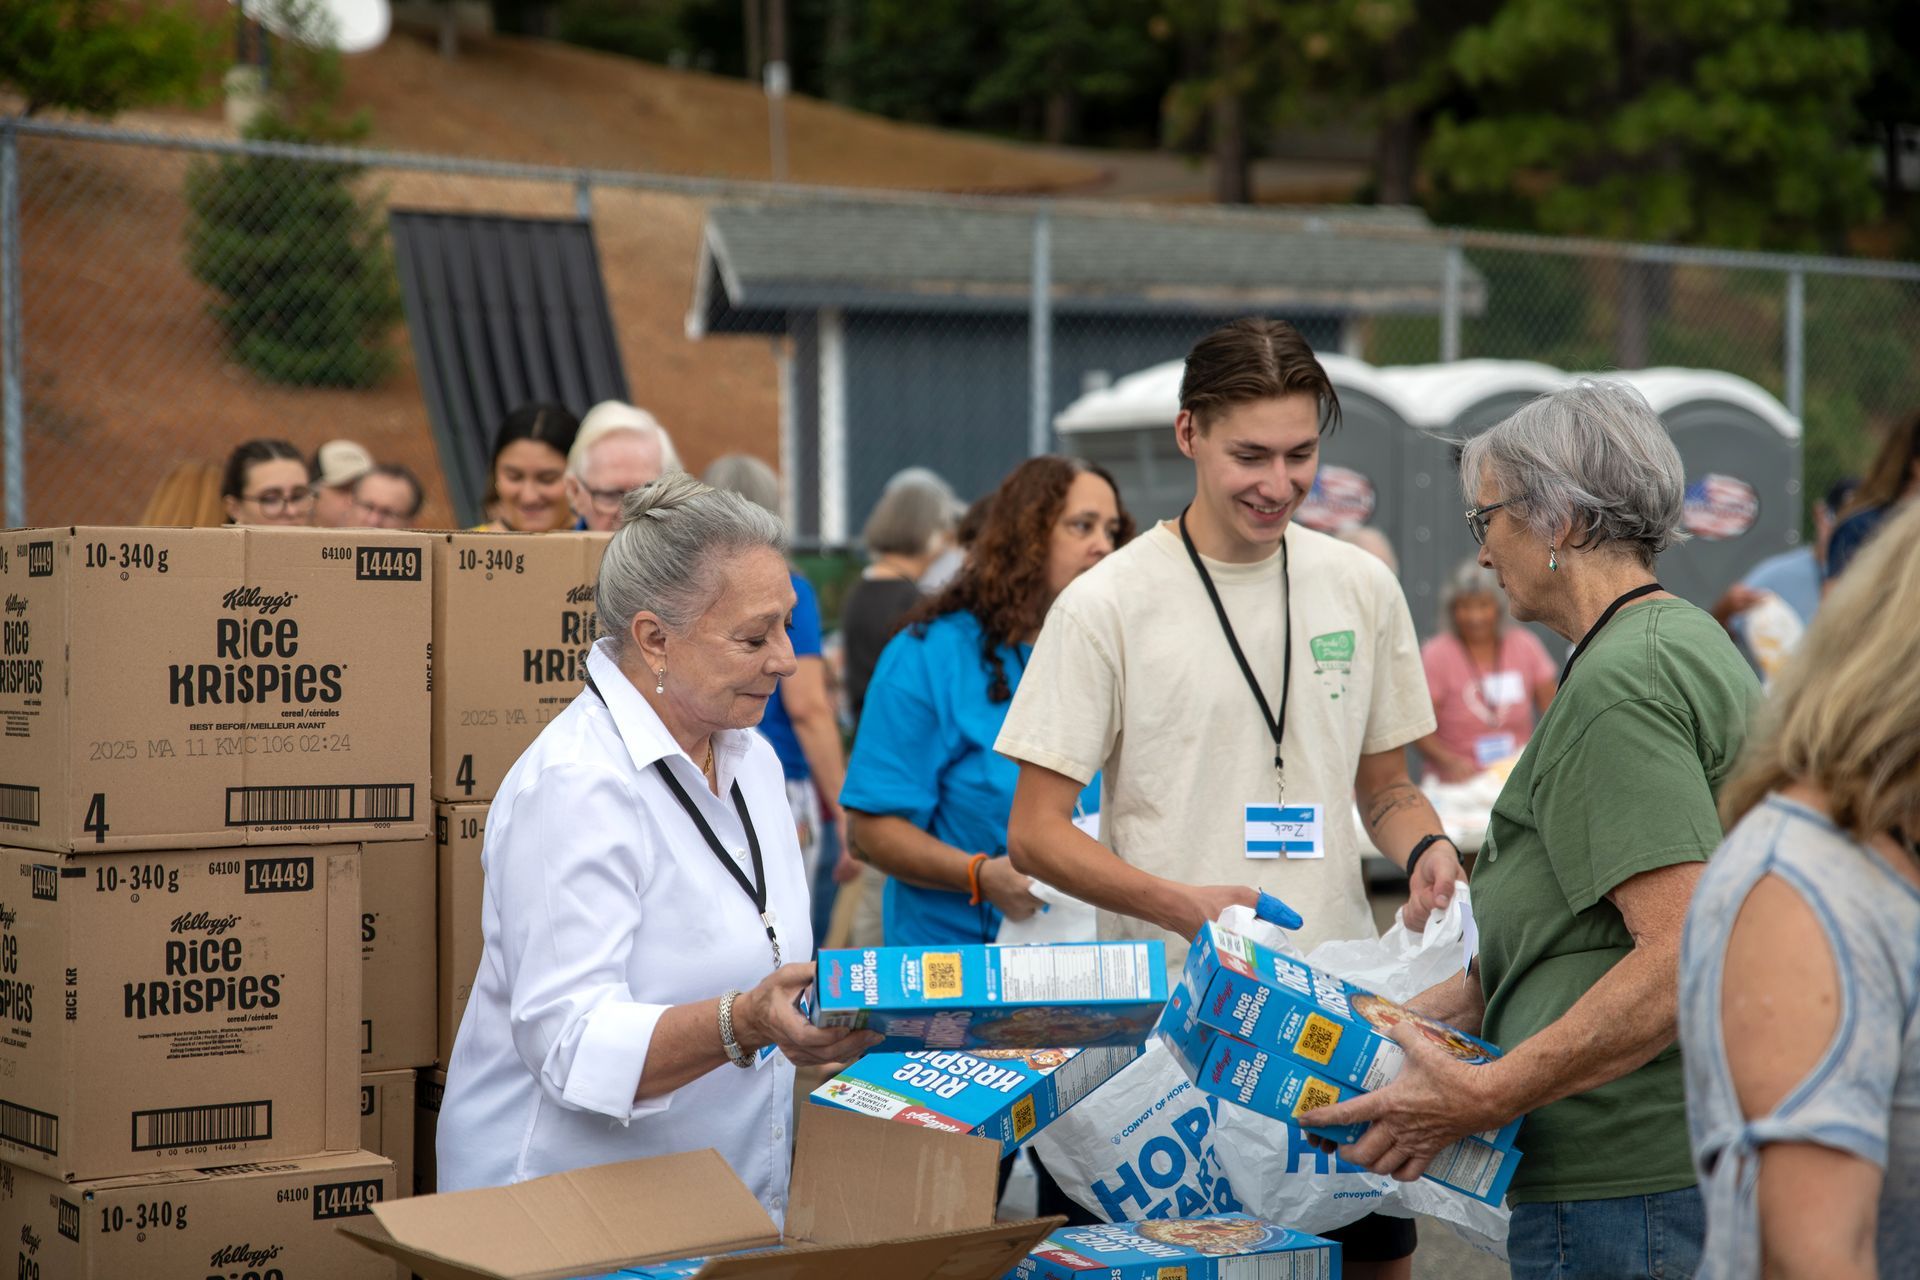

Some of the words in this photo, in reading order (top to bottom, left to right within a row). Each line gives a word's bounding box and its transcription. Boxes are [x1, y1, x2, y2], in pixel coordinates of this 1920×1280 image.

[31, 546, 52, 573] 14449
[321, 547, 352, 560] 64100
[360, 552, 417, 577] 14449
[223, 586, 294, 614] Kellogg's
[297, 722, 326, 730] AVANT
[461, 710, 499, 726] 2025
[89, 741, 138, 760] 2025
[148, 739, 176, 758] MA
[186, 738, 208, 757] 11
[215, 736, 258, 756] KMC
[262, 735, 294, 754] 106
[299, 734, 352, 752] 02:24
[456, 754, 476, 796] 4
[84, 793, 110, 843] 4
[208, 861, 240, 875] 64100
[249, 861, 309, 890] 14449
[170, 911, 237, 935] Kellogg's
[65, 968, 77, 986] KR
[906, 960, 917, 991] SCAN
[65, 989, 77, 1020] RICE
[1282, 1012, 1300, 1041] SCAN
[856, 1089, 889, 1104] MINERALS
[857, 1095, 887, 1109] VITAMINS
[1281, 1077, 1299, 1105] SCAN
[855, 1101, 881, 1113] SOURCE
[1121, 1106, 1154, 1137] CONVOY
[1155, 1098, 1167, 1111] OF
[1166, 1081, 1191, 1102] HOPE
[185, 1146, 208, 1154] 64100
[215, 1143, 237, 1152] 14449
[1090, 1095, 1219, 1223] HOP
[277, 1187, 309, 1203] 64100
[318, 1184, 378, 1215] 14449
[210, 1243, 279, 1268] Kellogg's
